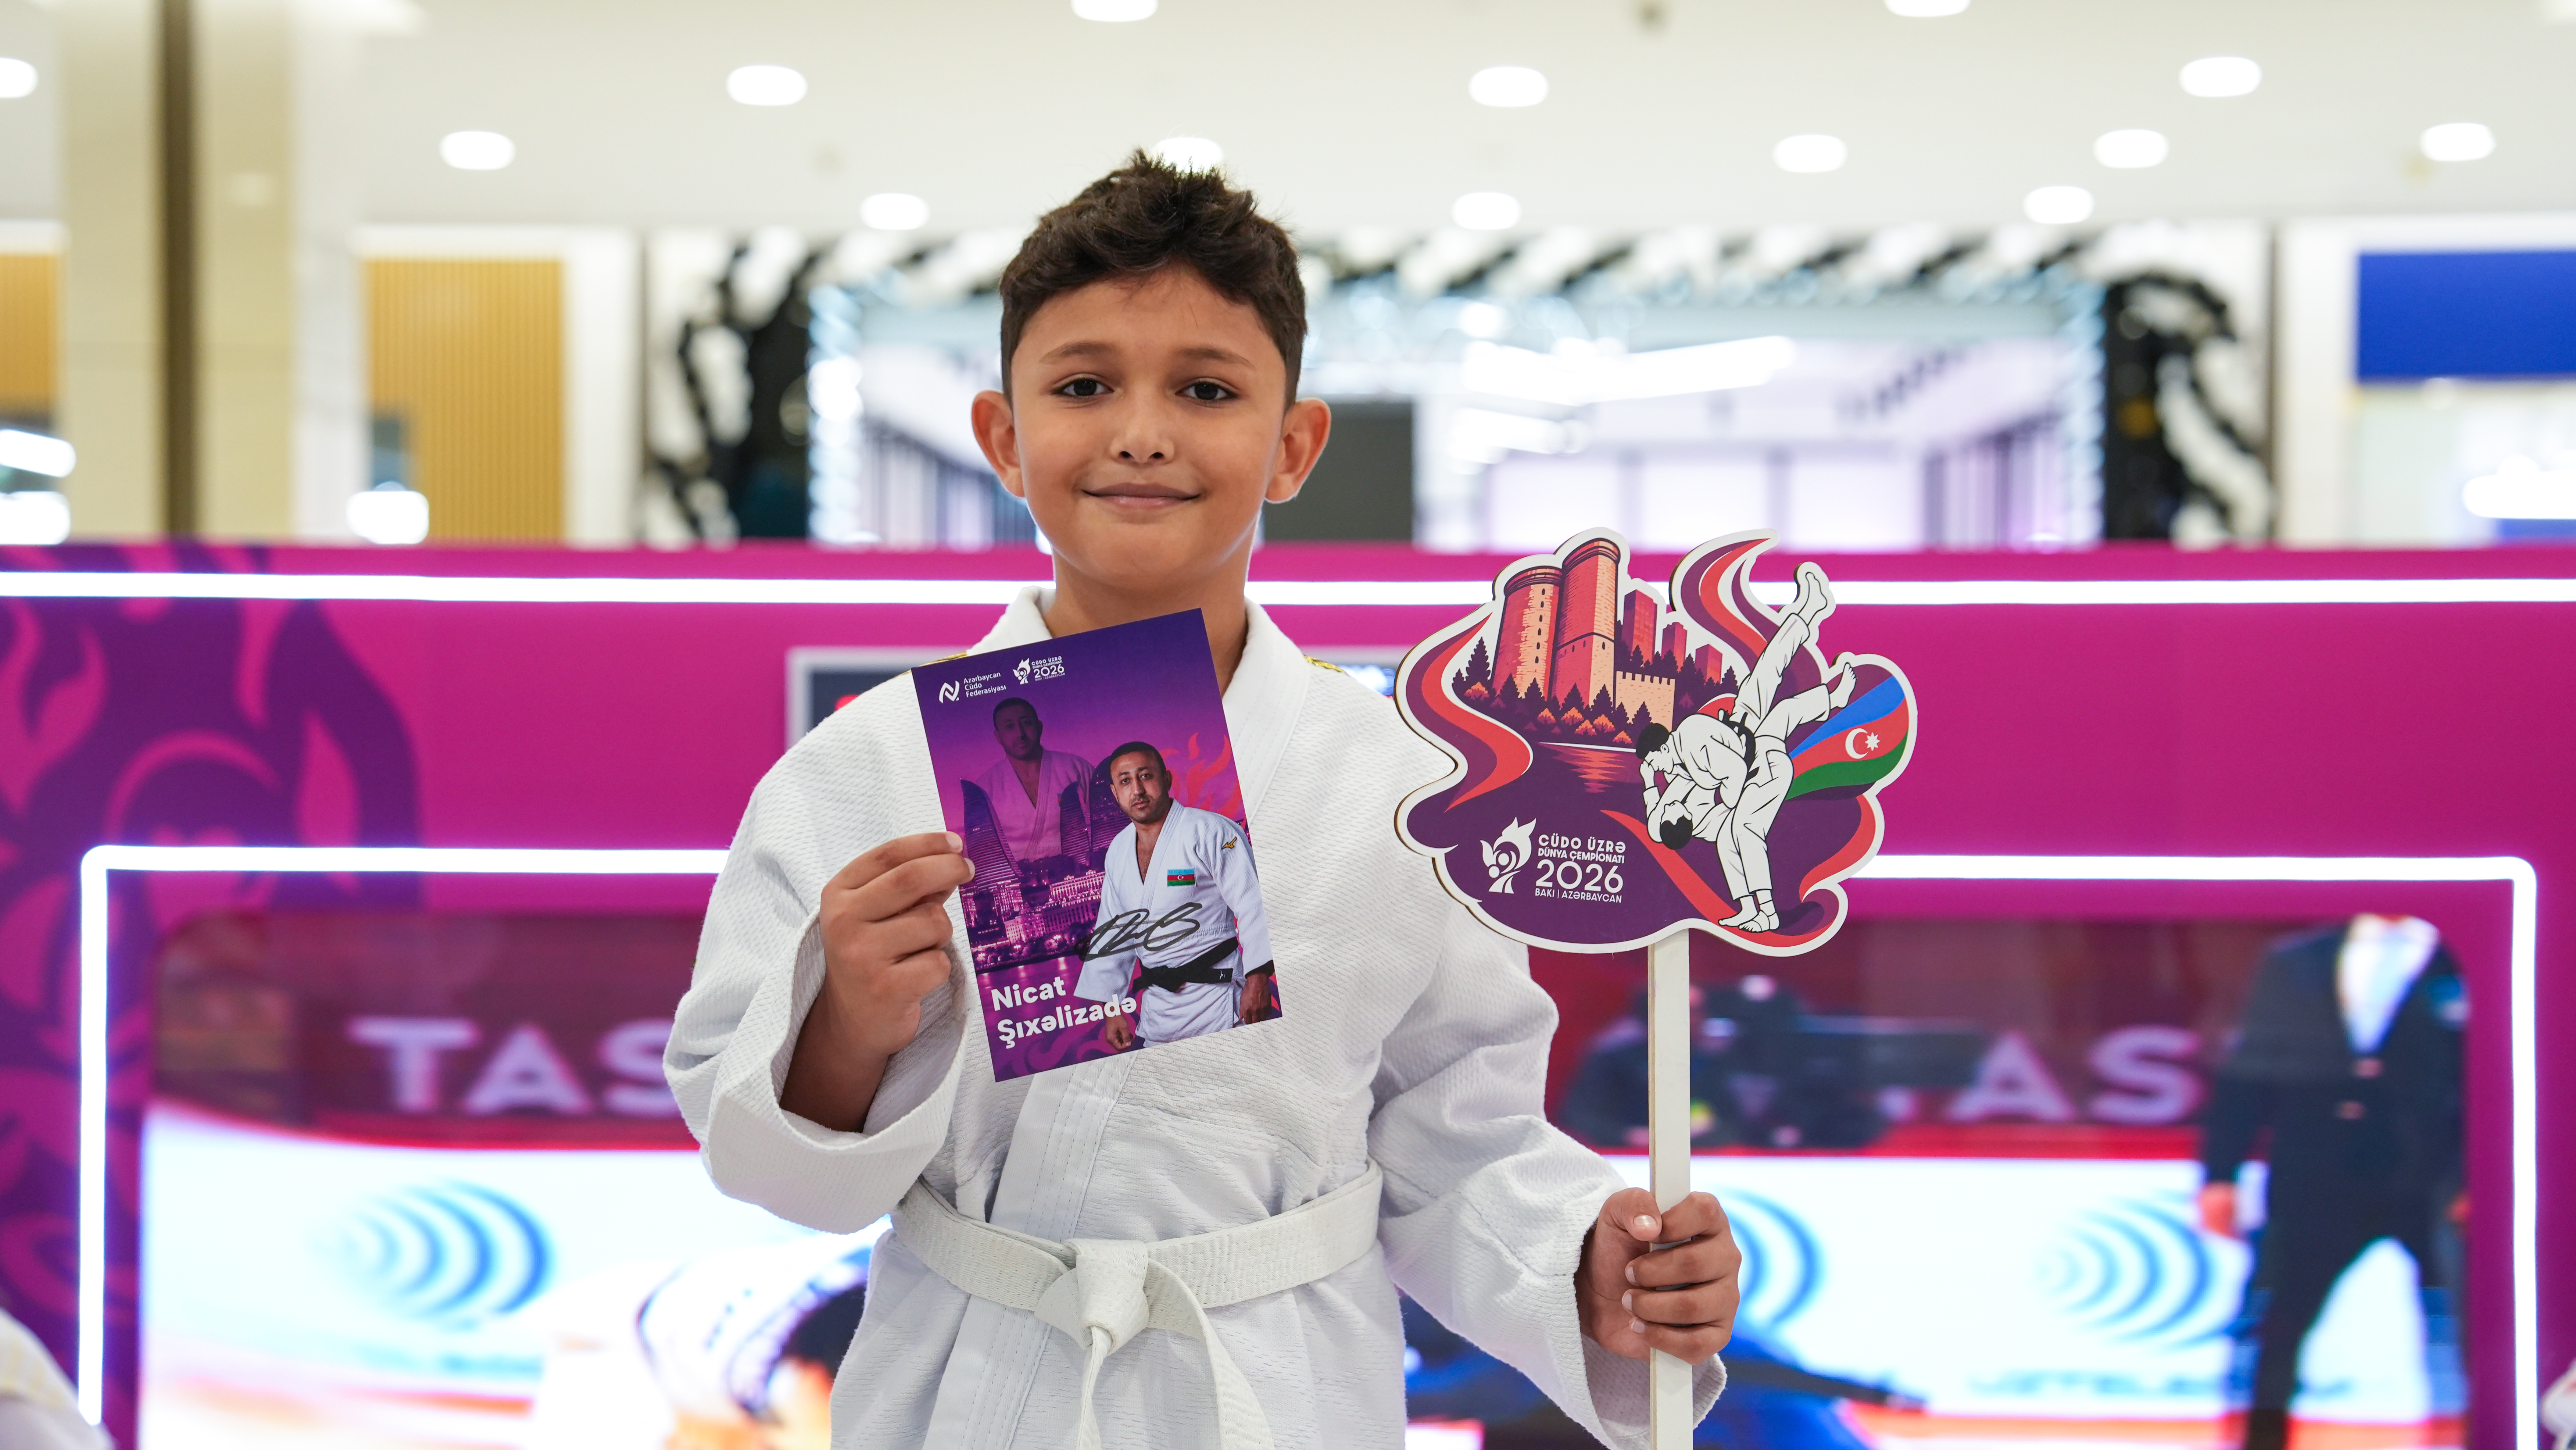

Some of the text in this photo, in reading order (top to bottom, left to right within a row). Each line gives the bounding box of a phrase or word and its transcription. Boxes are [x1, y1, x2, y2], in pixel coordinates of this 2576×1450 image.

[963, 672, 1001, 684] Azərbaycan
[1033, 664, 1065, 678] 2026
[965, 682, 982, 691] Cüdo
[966, 685, 1006, 697] Federasiyası
[1538, 833, 1626, 853] CÜDO ÜZRƏ
[1538, 846, 1625, 864] DÜNYA ÇEMPİONATI
[1535, 858, 1624, 893] 2026
[1535, 888, 1622, 903] BAKI AZƏRBAYCAN
[991, 975, 1067, 1011] Nicat
[997, 993, 1138, 1050] Şıxəlizadə
